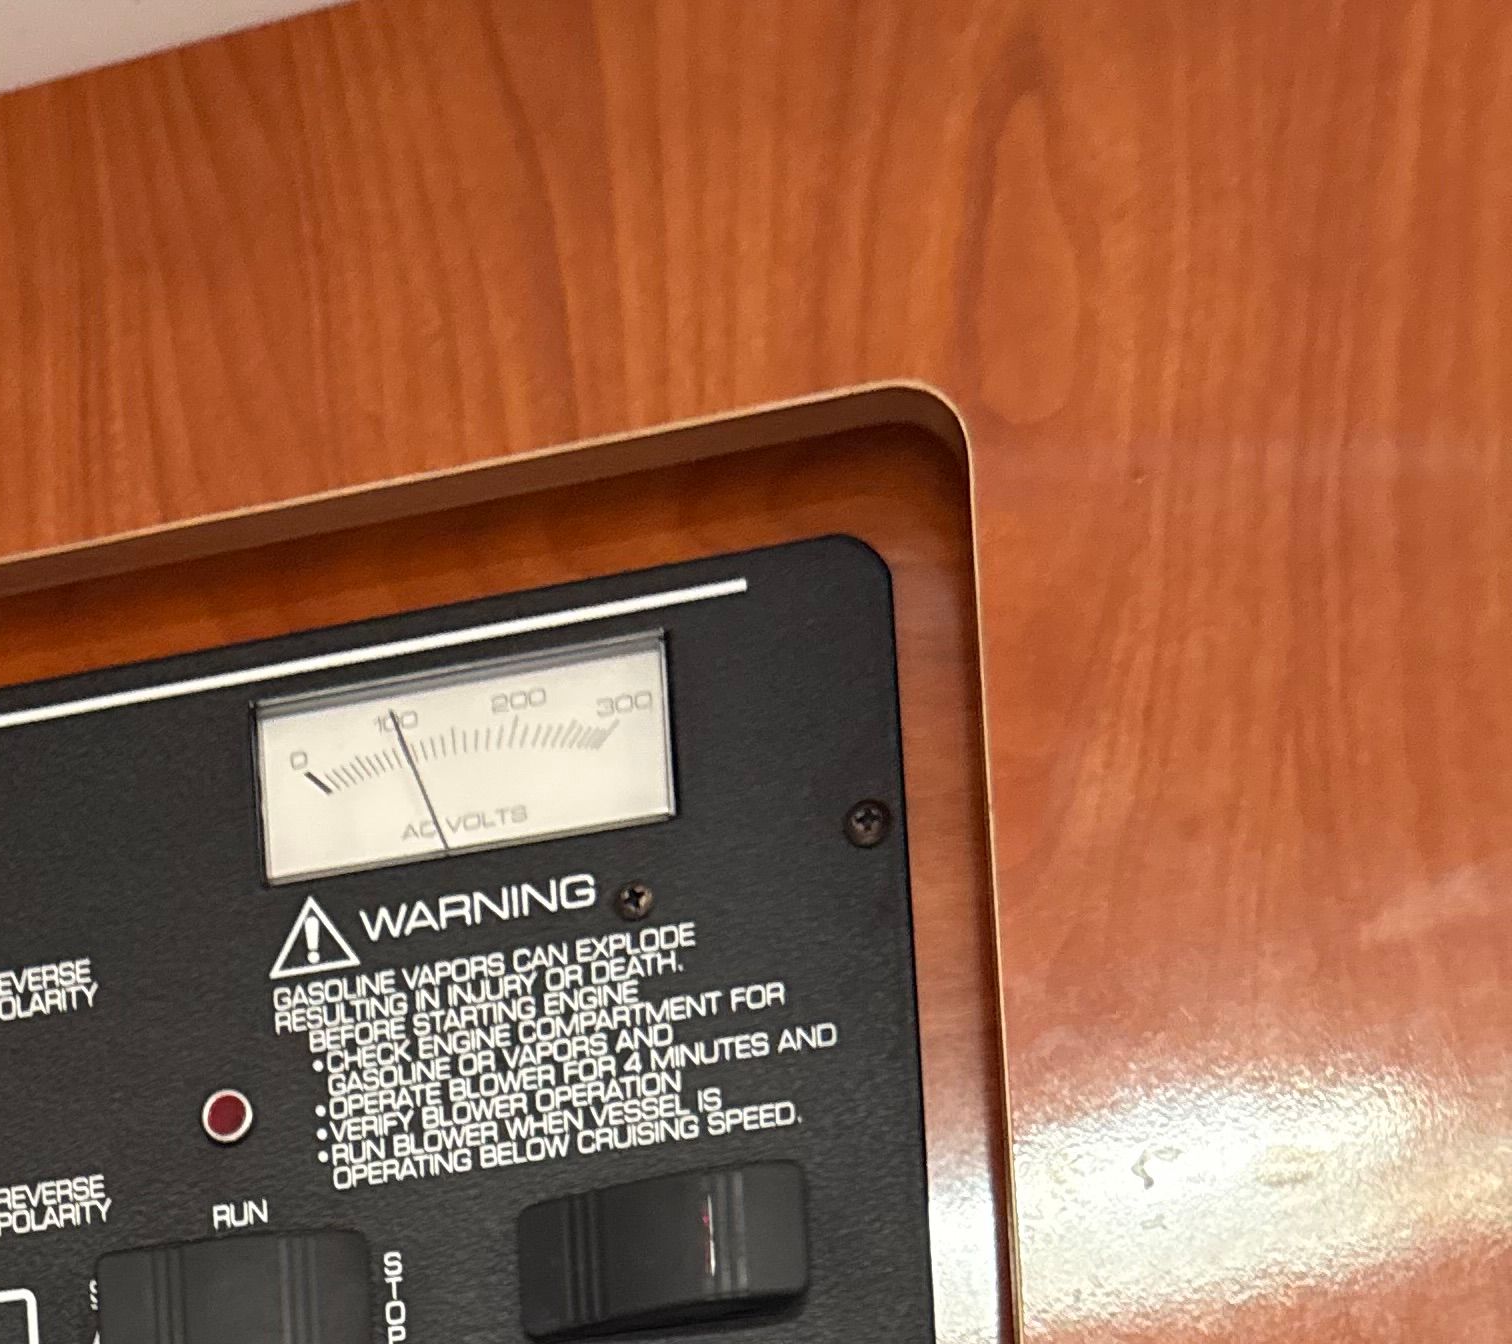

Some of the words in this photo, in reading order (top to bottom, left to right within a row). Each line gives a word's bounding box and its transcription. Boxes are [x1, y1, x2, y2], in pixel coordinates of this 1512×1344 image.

[373, 710, 419, 734] 100
[491, 687, 547, 714] 200
[595, 690, 653, 717] 300
[401, 820, 437, 841] AC
[445, 804, 528, 834] VOLTS
[359, 873, 596, 942] WARNING
[273, 969, 396, 1012] GASOLINE
[402, 951, 505, 990] VAPORS
[512, 941, 568, 974] CAN
[575, 921, 696, 964] EXPLODE
[309, 1015, 407, 1053] BEFORE
[413, 998, 536, 1035] STARTING
[543, 980, 639, 1016] ENGINE
[327, 1039, 412, 1073] CHECK
[418, 1024, 512, 1059] ENGINE
[518, 991, 723, 1042] COMPARTMENT
[730, 982, 786, 1012] FOR
[328, 1057, 451, 1097] GASOLINE
[458, 1052, 496, 1077] OR
[502, 1033, 608, 1069] VAPORS
[615, 1024, 674, 1053] AND
[330, 1109, 414, 1142] VERIFY
[422, 1093, 527, 1130] BLOWER
[535, 1071, 682, 1113] OPERATION
[331, 1138, 386, 1167] RUN
[393, 1121, 498, 1158] BLOWER
[505, 1109, 584, 1139] WHEN
[590, 1094, 690, 1128] VESSEL
[697, 1088, 722, 1112] IS
[213, 1199, 269, 1230] RUN
